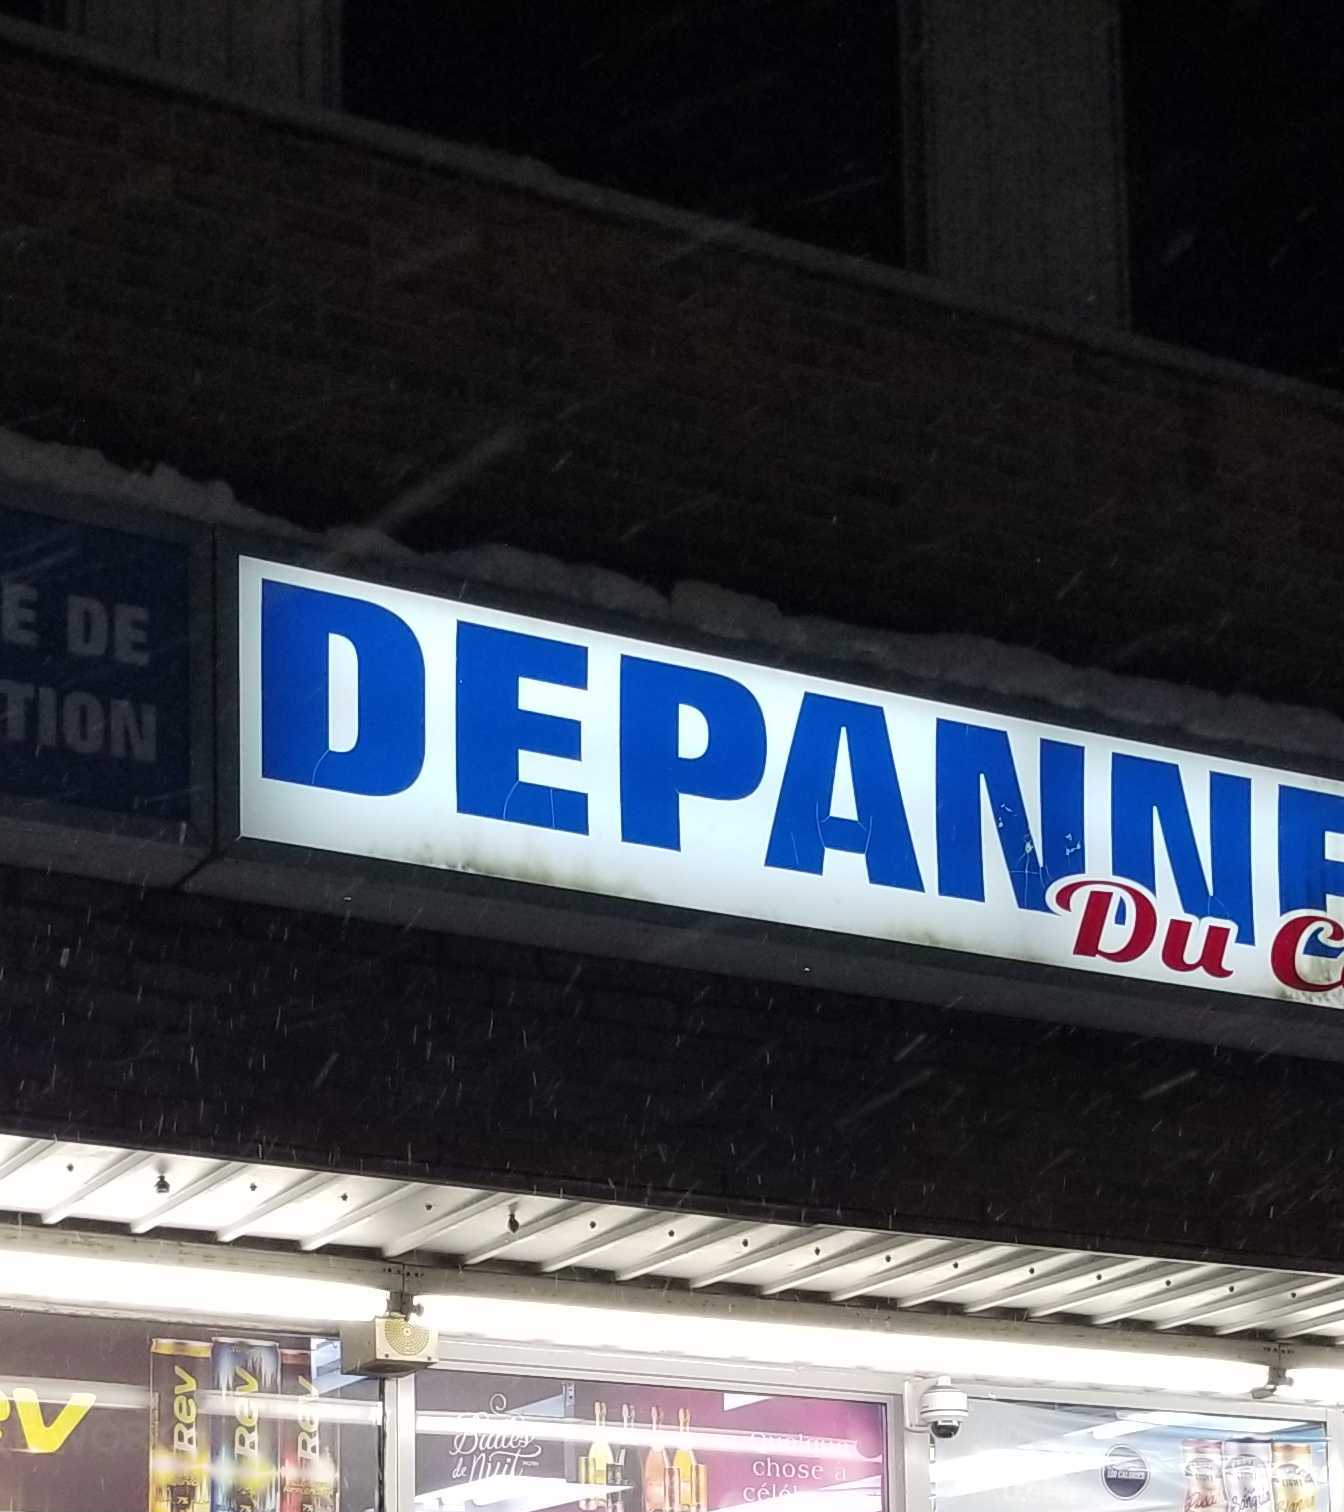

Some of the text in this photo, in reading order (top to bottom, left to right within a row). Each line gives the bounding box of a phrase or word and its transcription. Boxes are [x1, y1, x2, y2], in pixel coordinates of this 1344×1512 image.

[66, 594, 151, 666] DE
[1055, 876, 1237, 980] Du
[173, 1365, 197, 1455] Rev
[235, 1365, 259, 1457] Rev
[297, 1375, 319, 1463] Rev
[752, 1457, 824, 1479] chose
